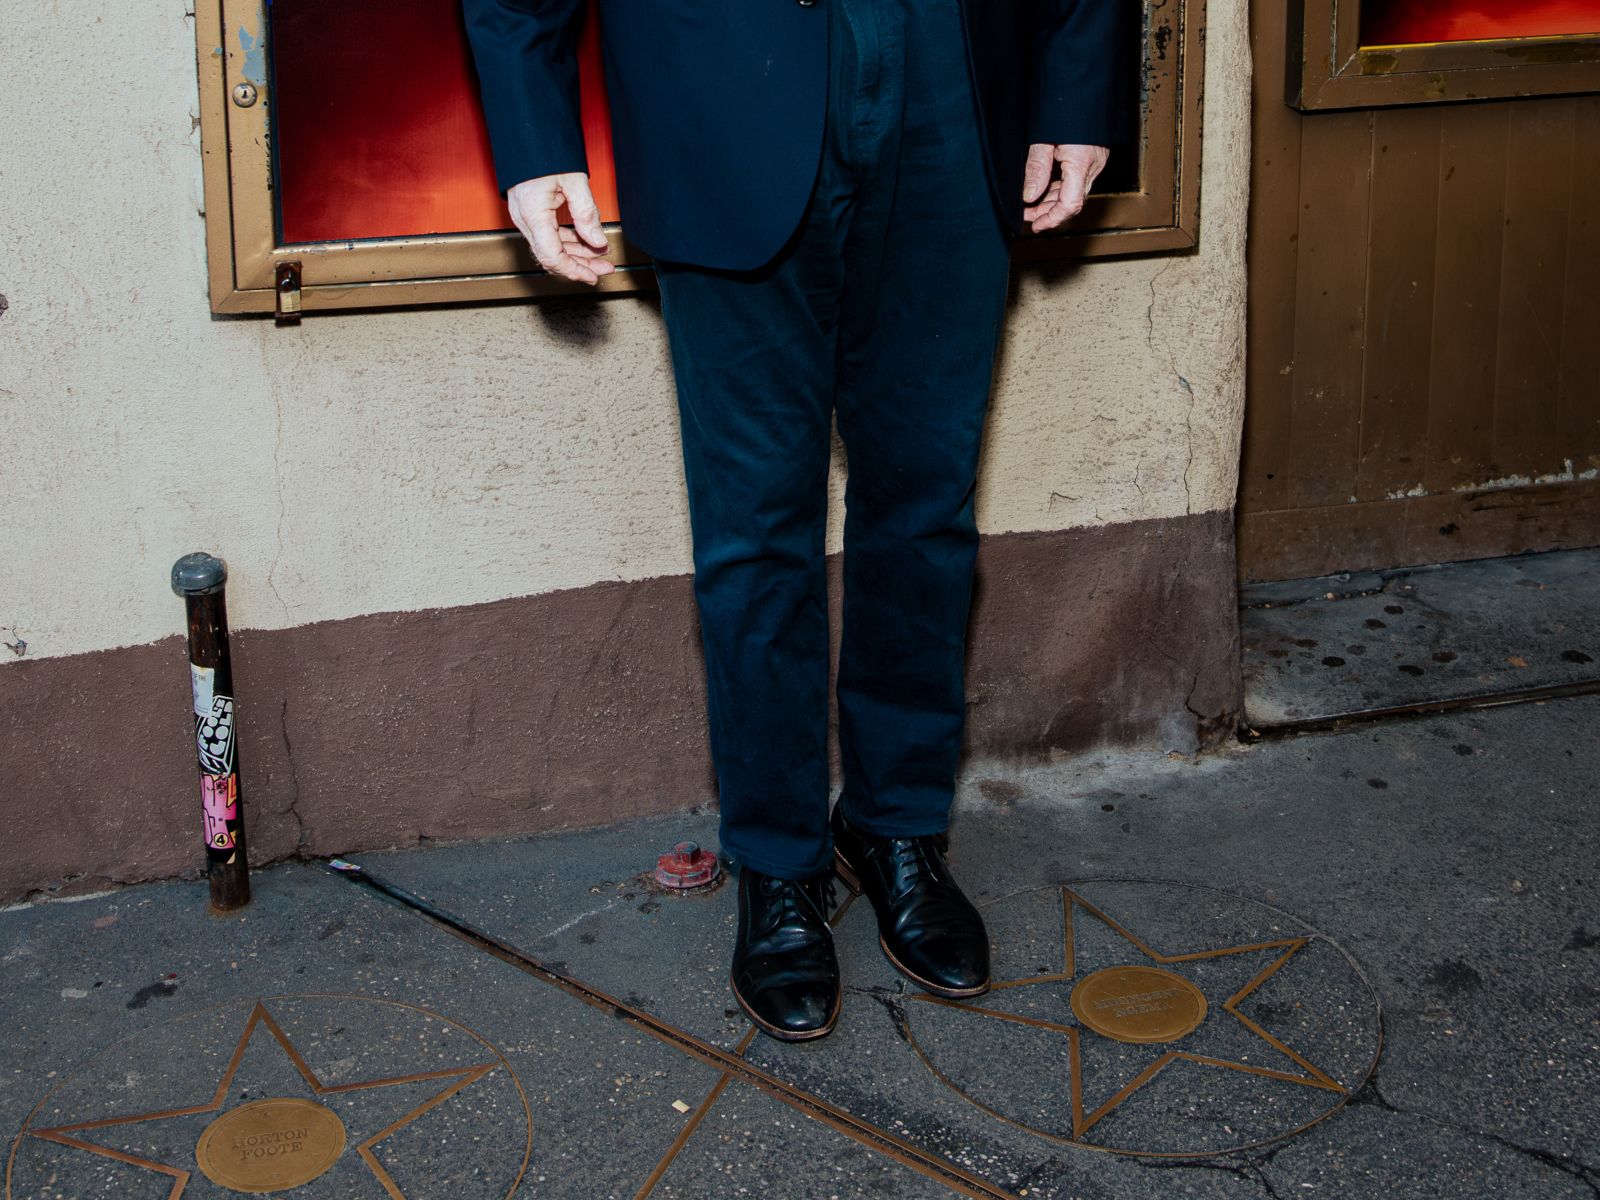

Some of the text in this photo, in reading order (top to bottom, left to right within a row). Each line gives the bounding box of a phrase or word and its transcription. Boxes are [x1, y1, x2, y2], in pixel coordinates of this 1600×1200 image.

[216, 834, 226, 845] 4
[231, 1128, 309, 1149] HORTON
[240, 1141, 303, 1160] FOOTE
